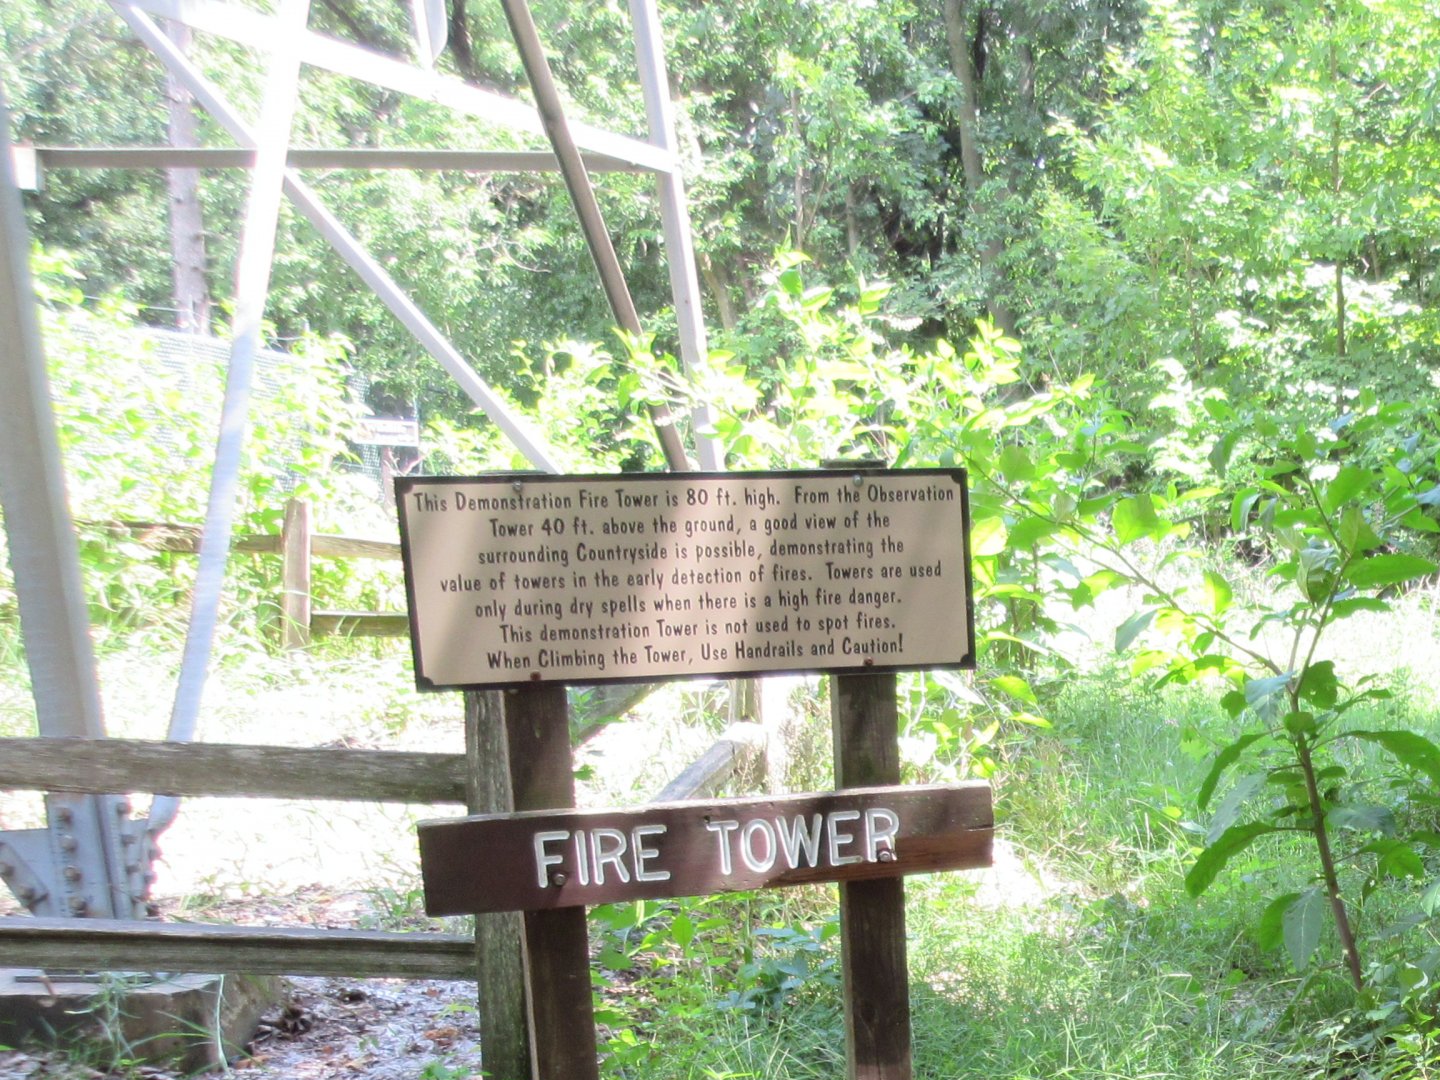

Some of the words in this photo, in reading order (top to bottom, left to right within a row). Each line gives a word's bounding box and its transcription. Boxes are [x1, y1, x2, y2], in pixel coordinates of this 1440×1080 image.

[413, 492, 448, 512] This
[455, 490, 571, 511] Demonstration
[579, 489, 608, 508] Fire
[615, 489, 658, 507] Tower
[666, 490, 678, 507] is
[686, 489, 708, 506] 80
[716, 488, 737, 506] ft.
[744, 487, 781, 510] high.
[794, 486, 829, 504] From
[837, 485, 860, 503] the
[867, 484, 954, 502] Observation
[489, 518, 534, 537] Tower
[541, 518, 565, 535] 40
[573, 517, 594, 535] ft.
[602, 517, 645, 535] above
[653, 516, 677, 534] the
[685, 514, 741, 537] ground,
[750, 518, 757, 531] a
[764, 513, 797, 536] good
[805, 514, 836, 530] view
[844, 511, 859, 529] of
[867, 511, 890, 528] the
[478, 545, 569, 567] surrounding
[577, 542, 668, 565] Countryside
[675, 543, 688, 559] is
[696, 540, 762, 562] possible,
[770, 537, 874, 560] demonstrating
[881, 537, 904, 553] the
[440, 574, 482, 592] value
[489, 572, 505, 590] of
[514, 573, 565, 590] towers
[573, 572, 586, 588] in
[595, 570, 619, 587] the
[627, 567, 663, 589] early
[672, 567, 742, 586] detection
[749, 566, 764, 583] of
[773, 565, 813, 581] fires.
[825, 562, 873, 580] Towers
[881, 565, 902, 578] are
[909, 561, 942, 577] used
[475, 600, 506, 621] only
[514, 598, 563, 620] during
[570, 597, 593, 618] dry
[601, 595, 646, 617] spells
[653, 594, 691, 611] when
[699, 592, 737, 610] there
[745, 593, 756, 608] is
[764, 597, 772, 608] a
[779, 590, 809, 612] high
[816, 590, 842, 605] fire
[849, 588, 902, 609] danger.
[499, 624, 532, 643] This
[540, 622, 650, 642] demonstration
[656, 619, 697, 637] Tower
[705, 620, 717, 635] is
[725, 618, 748, 635] not
[756, 616, 789, 633] used
[796, 616, 811, 631] to
[818, 615, 849, 635] spot
[857, 612, 896, 630] fires.
[487, 651, 531, 669] When
[538, 649, 606, 671] Climbing
[613, 647, 638, 665] the
[644, 645, 693, 665] Tower,
[701, 643, 728, 661] Use
[735, 640, 803, 659] Handrails
[811, 639, 835, 655] and
[842, 633, 904, 655] Caution!
[533, 824, 671, 889] FIRE
[706, 807, 900, 875] TOWER
